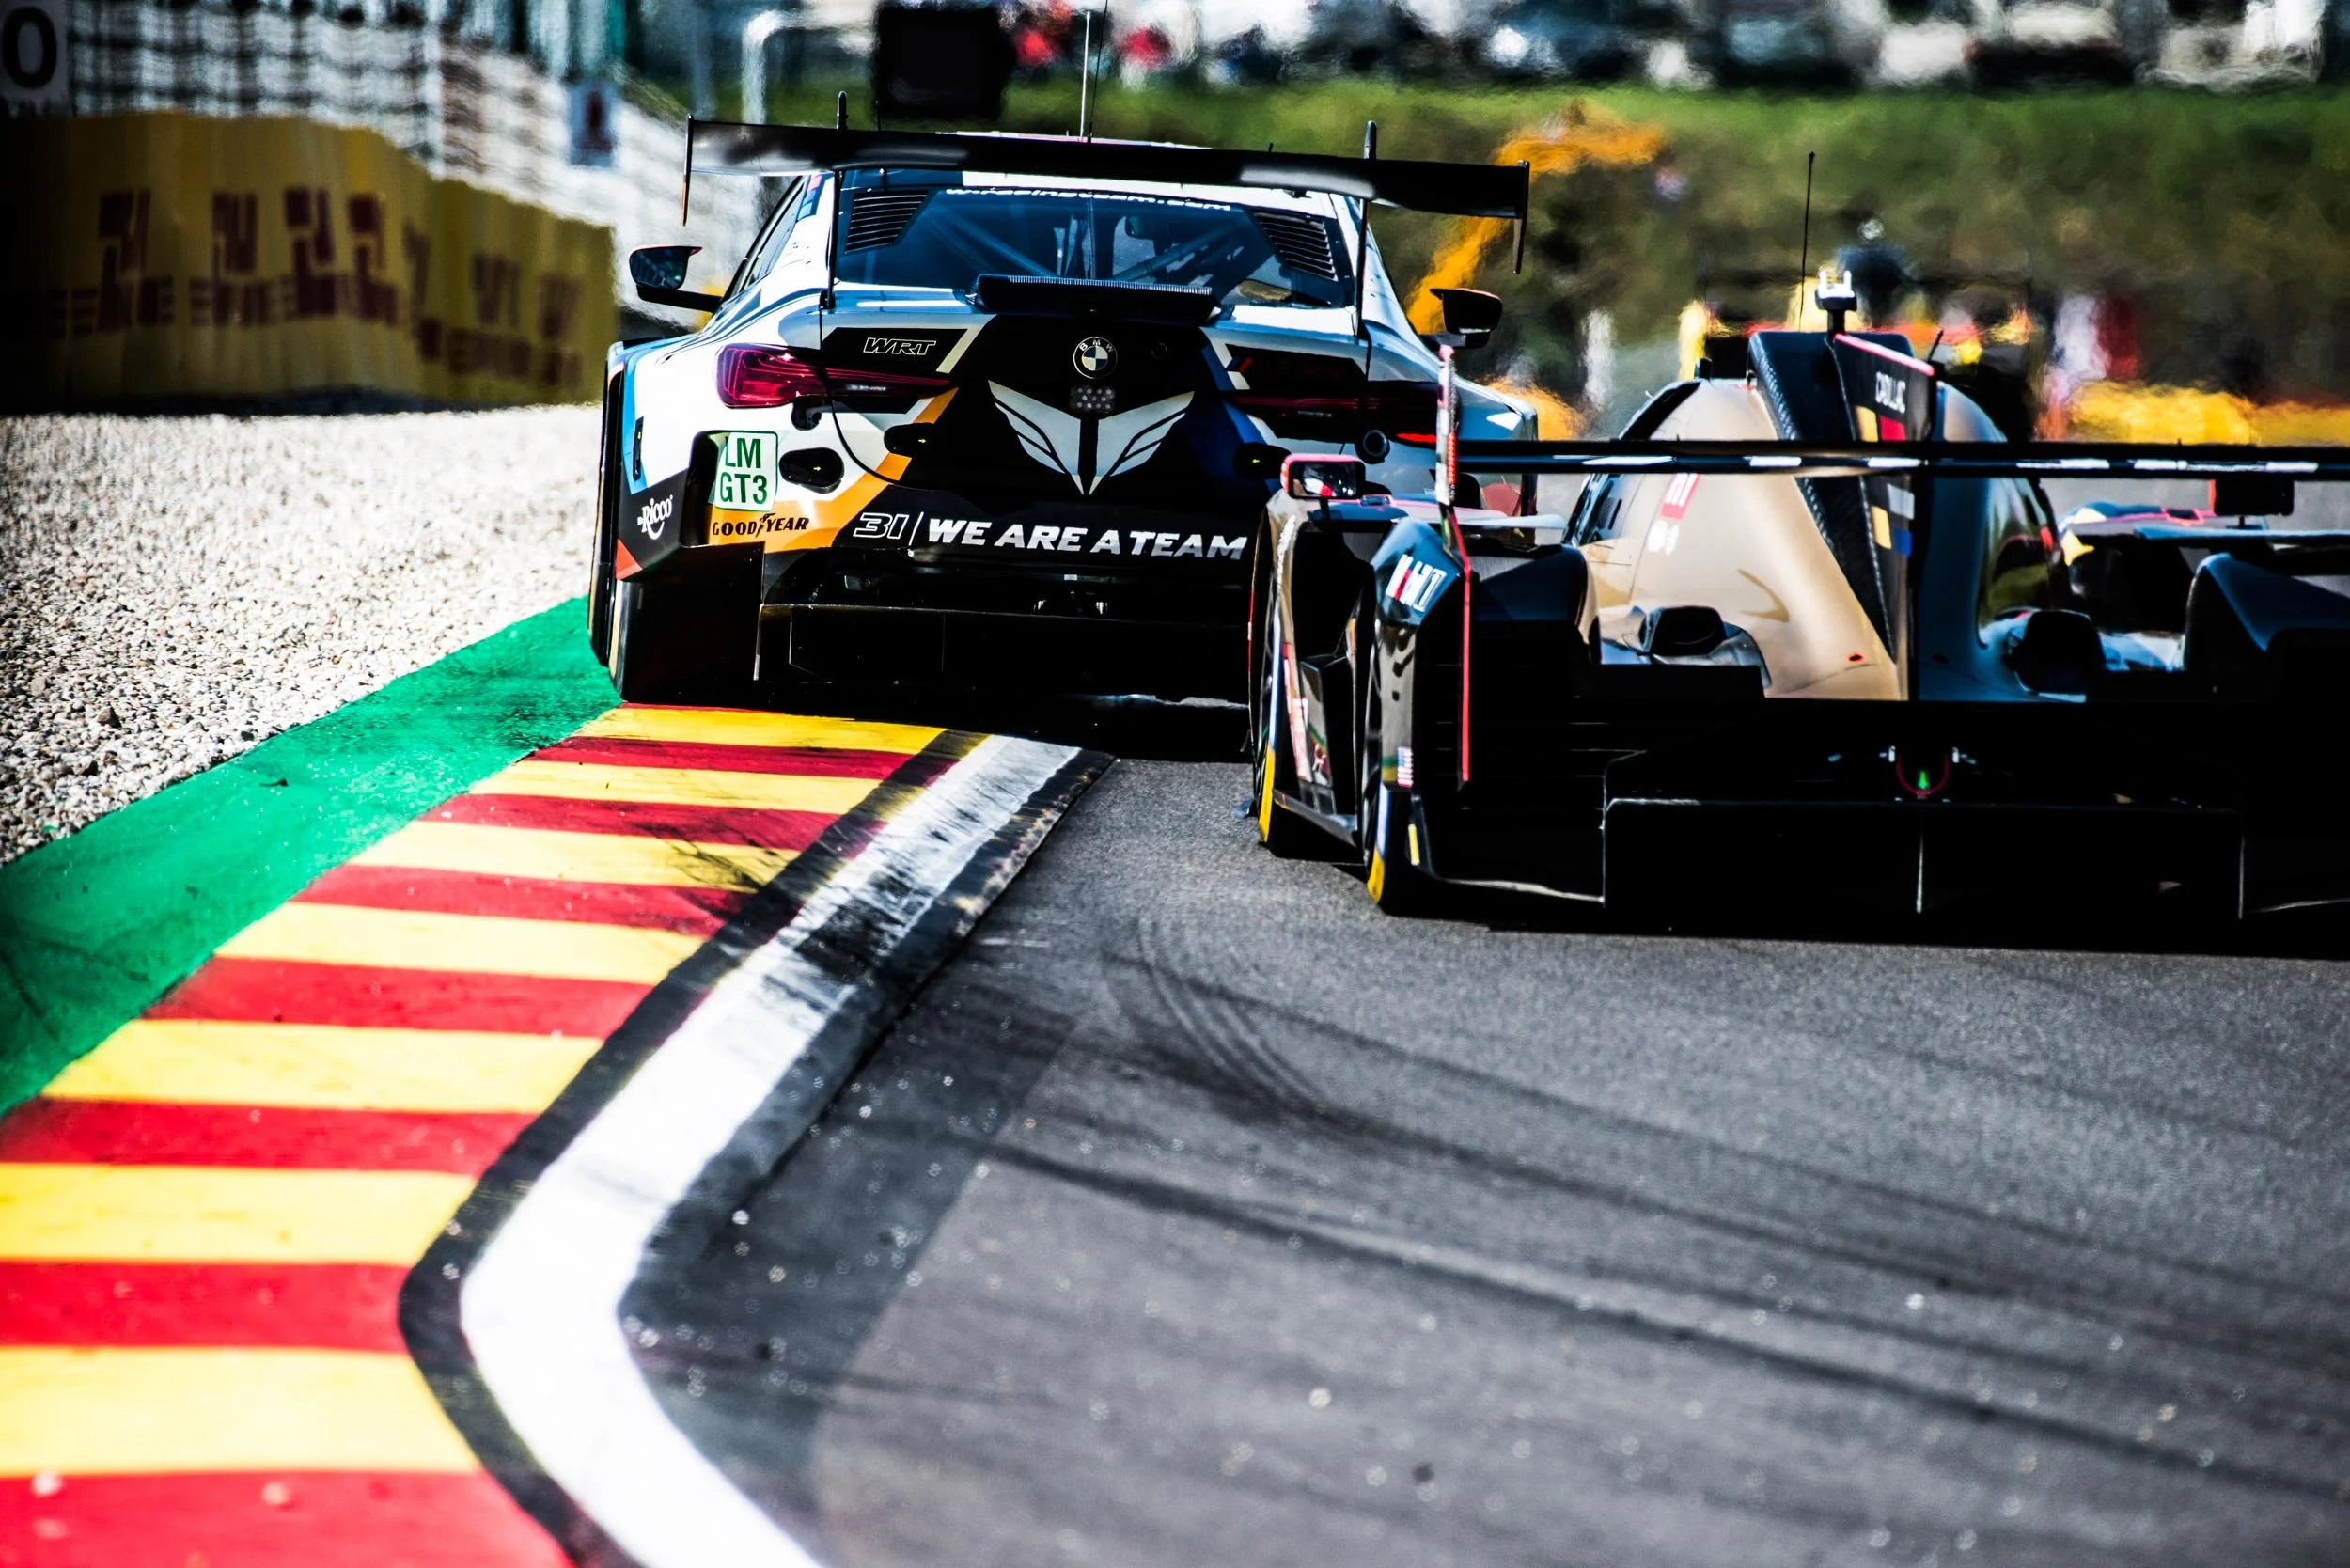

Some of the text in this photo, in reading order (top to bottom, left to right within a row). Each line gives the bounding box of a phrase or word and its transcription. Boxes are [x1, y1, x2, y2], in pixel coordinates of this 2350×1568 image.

[863, 337, 936, 355] WRT
[1079, 338, 1114, 353] BMW
[725, 436, 762, 469] LM
[720, 472, 768, 505] GT3
[713, 514, 809, 538] GOODYEAR
[853, 511, 1248, 561] 31 WE ARE A TEAM
